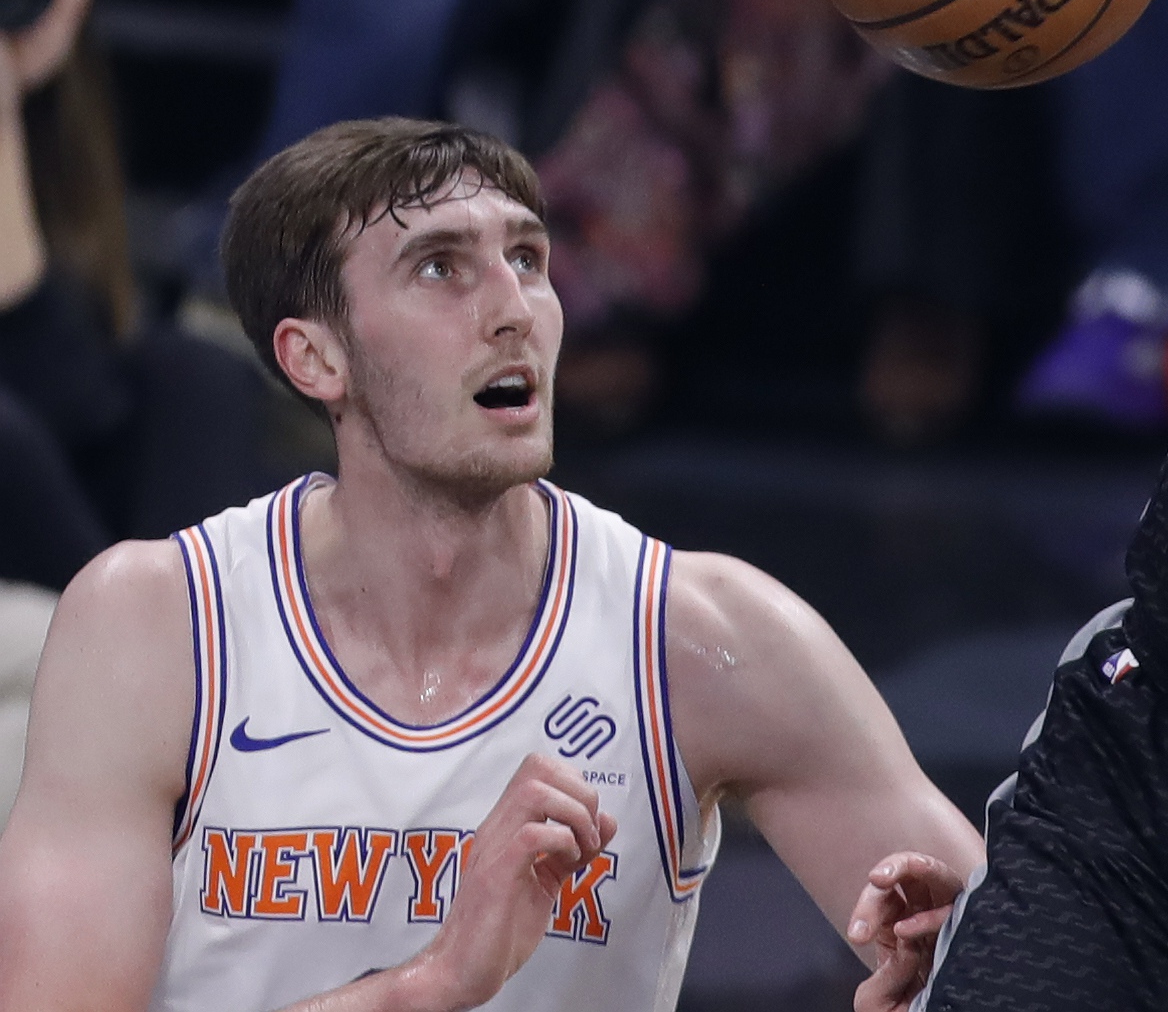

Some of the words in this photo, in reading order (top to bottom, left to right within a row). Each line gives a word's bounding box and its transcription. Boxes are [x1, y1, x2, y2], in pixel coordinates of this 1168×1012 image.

[582, 770, 626, 785] SPACE
[200, 826, 399, 923] NEW
[402, 826, 617, 946] YK
